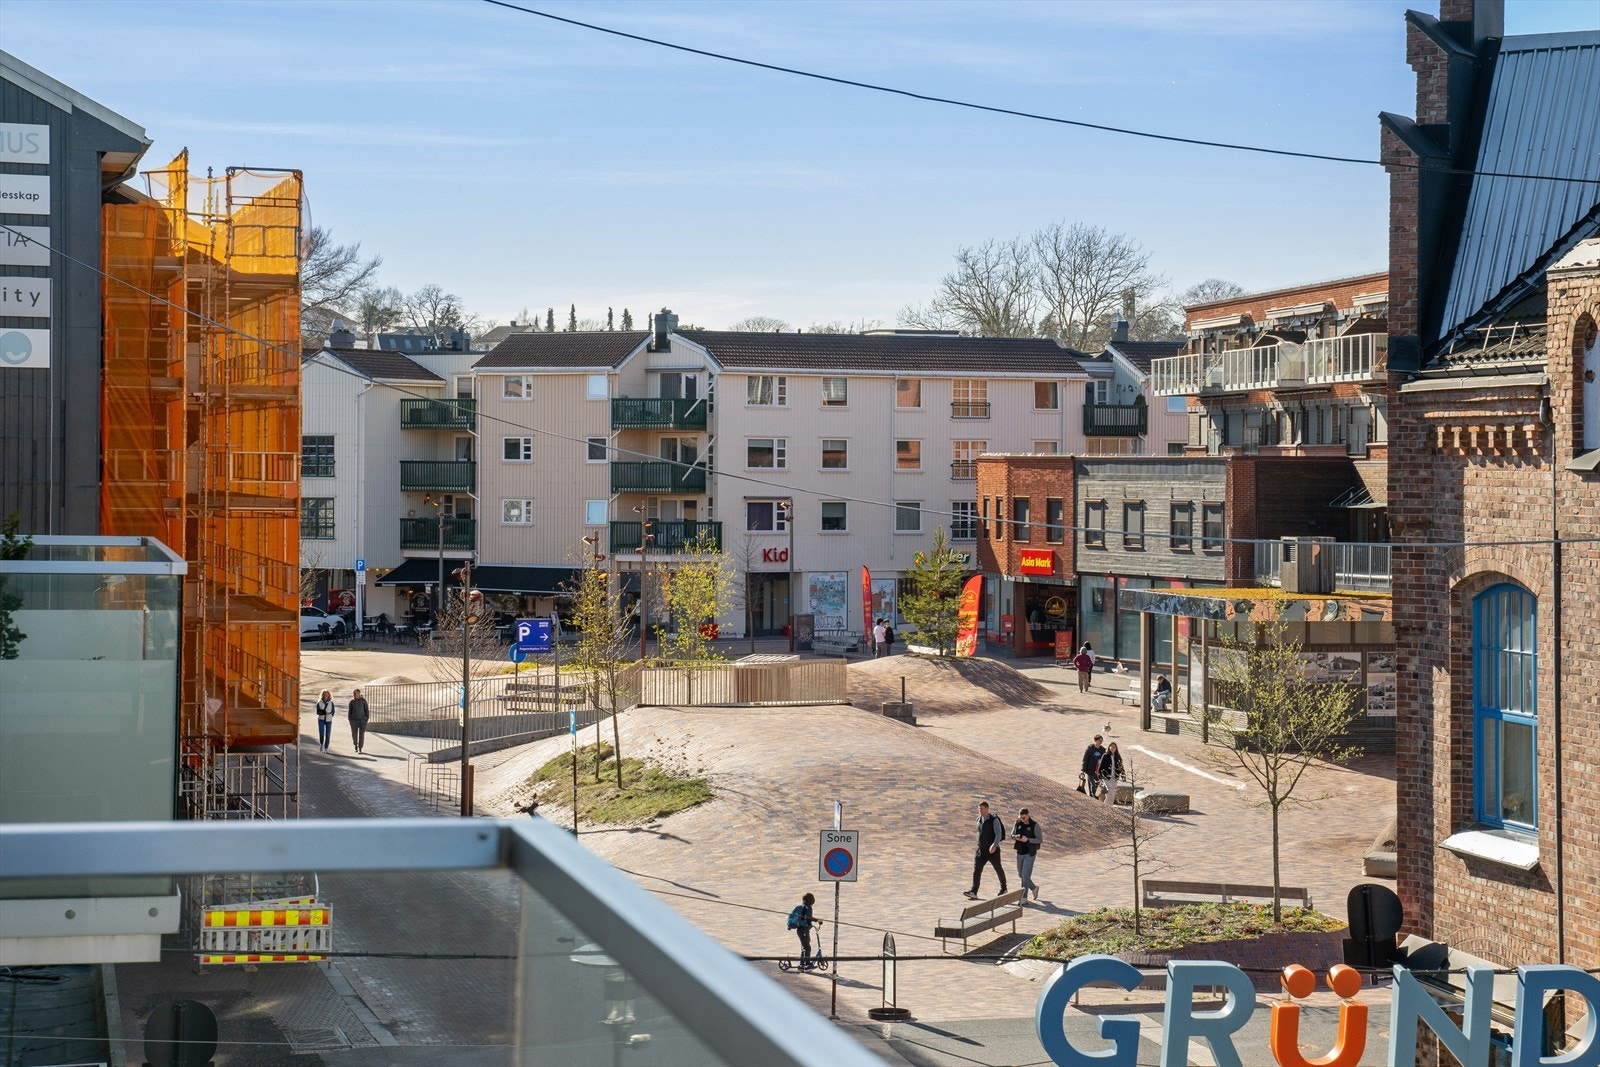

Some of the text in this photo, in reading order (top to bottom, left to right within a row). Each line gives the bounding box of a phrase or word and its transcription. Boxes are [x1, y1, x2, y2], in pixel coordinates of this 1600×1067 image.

[762, 547, 789, 562] Kid
[1021, 556, 1052, 568] Asia Mark
[518, 626, 531, 642] P
[826, 833, 852, 843] Sone
[1036, 954, 1600, 1067] GRÜND
